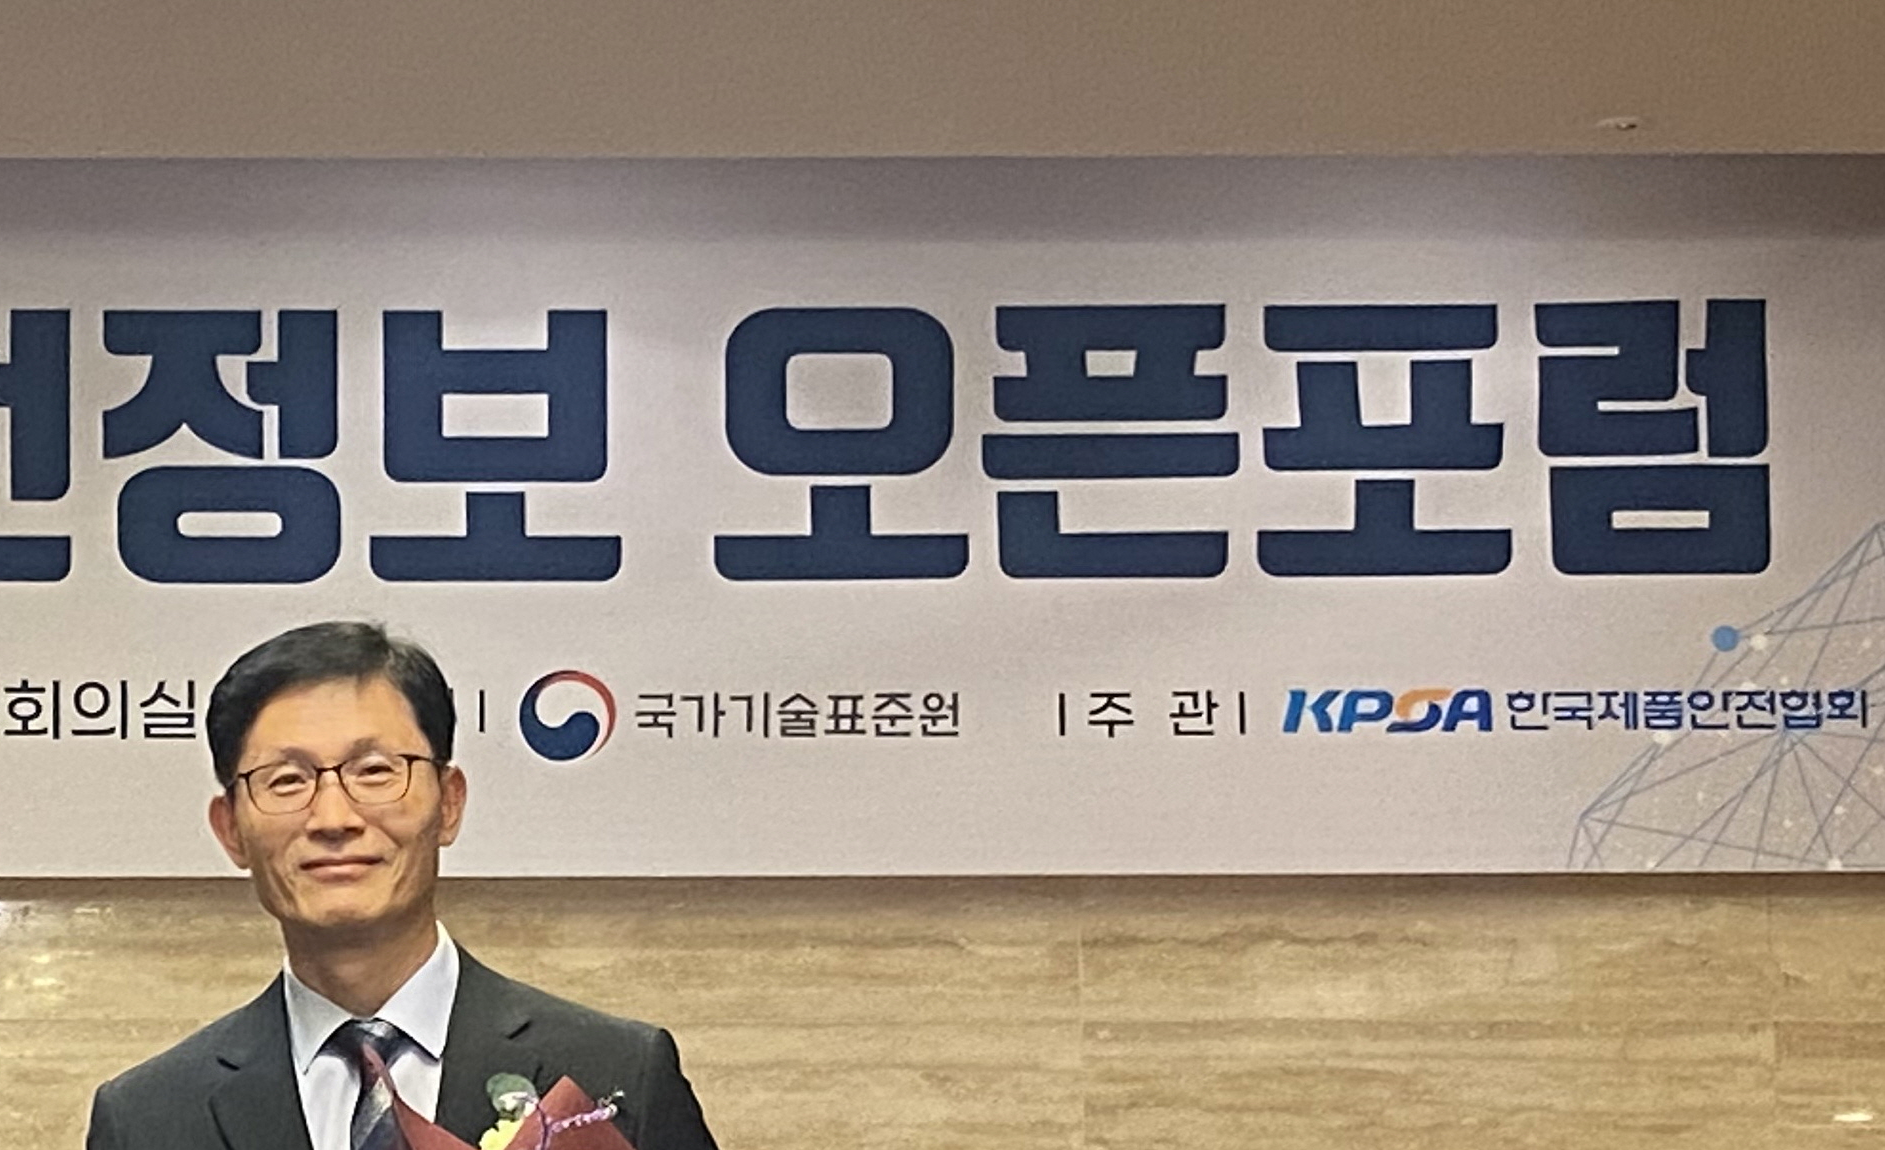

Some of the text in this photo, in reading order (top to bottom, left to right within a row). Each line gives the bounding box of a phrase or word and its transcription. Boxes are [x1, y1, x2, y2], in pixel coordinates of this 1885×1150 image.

[713, 298, 1772, 582] 오픈포럼
[634, 691, 960, 739] 국가기술표준원
[1282, 688, 1869, 734] KPSA 한국제품안전협회
